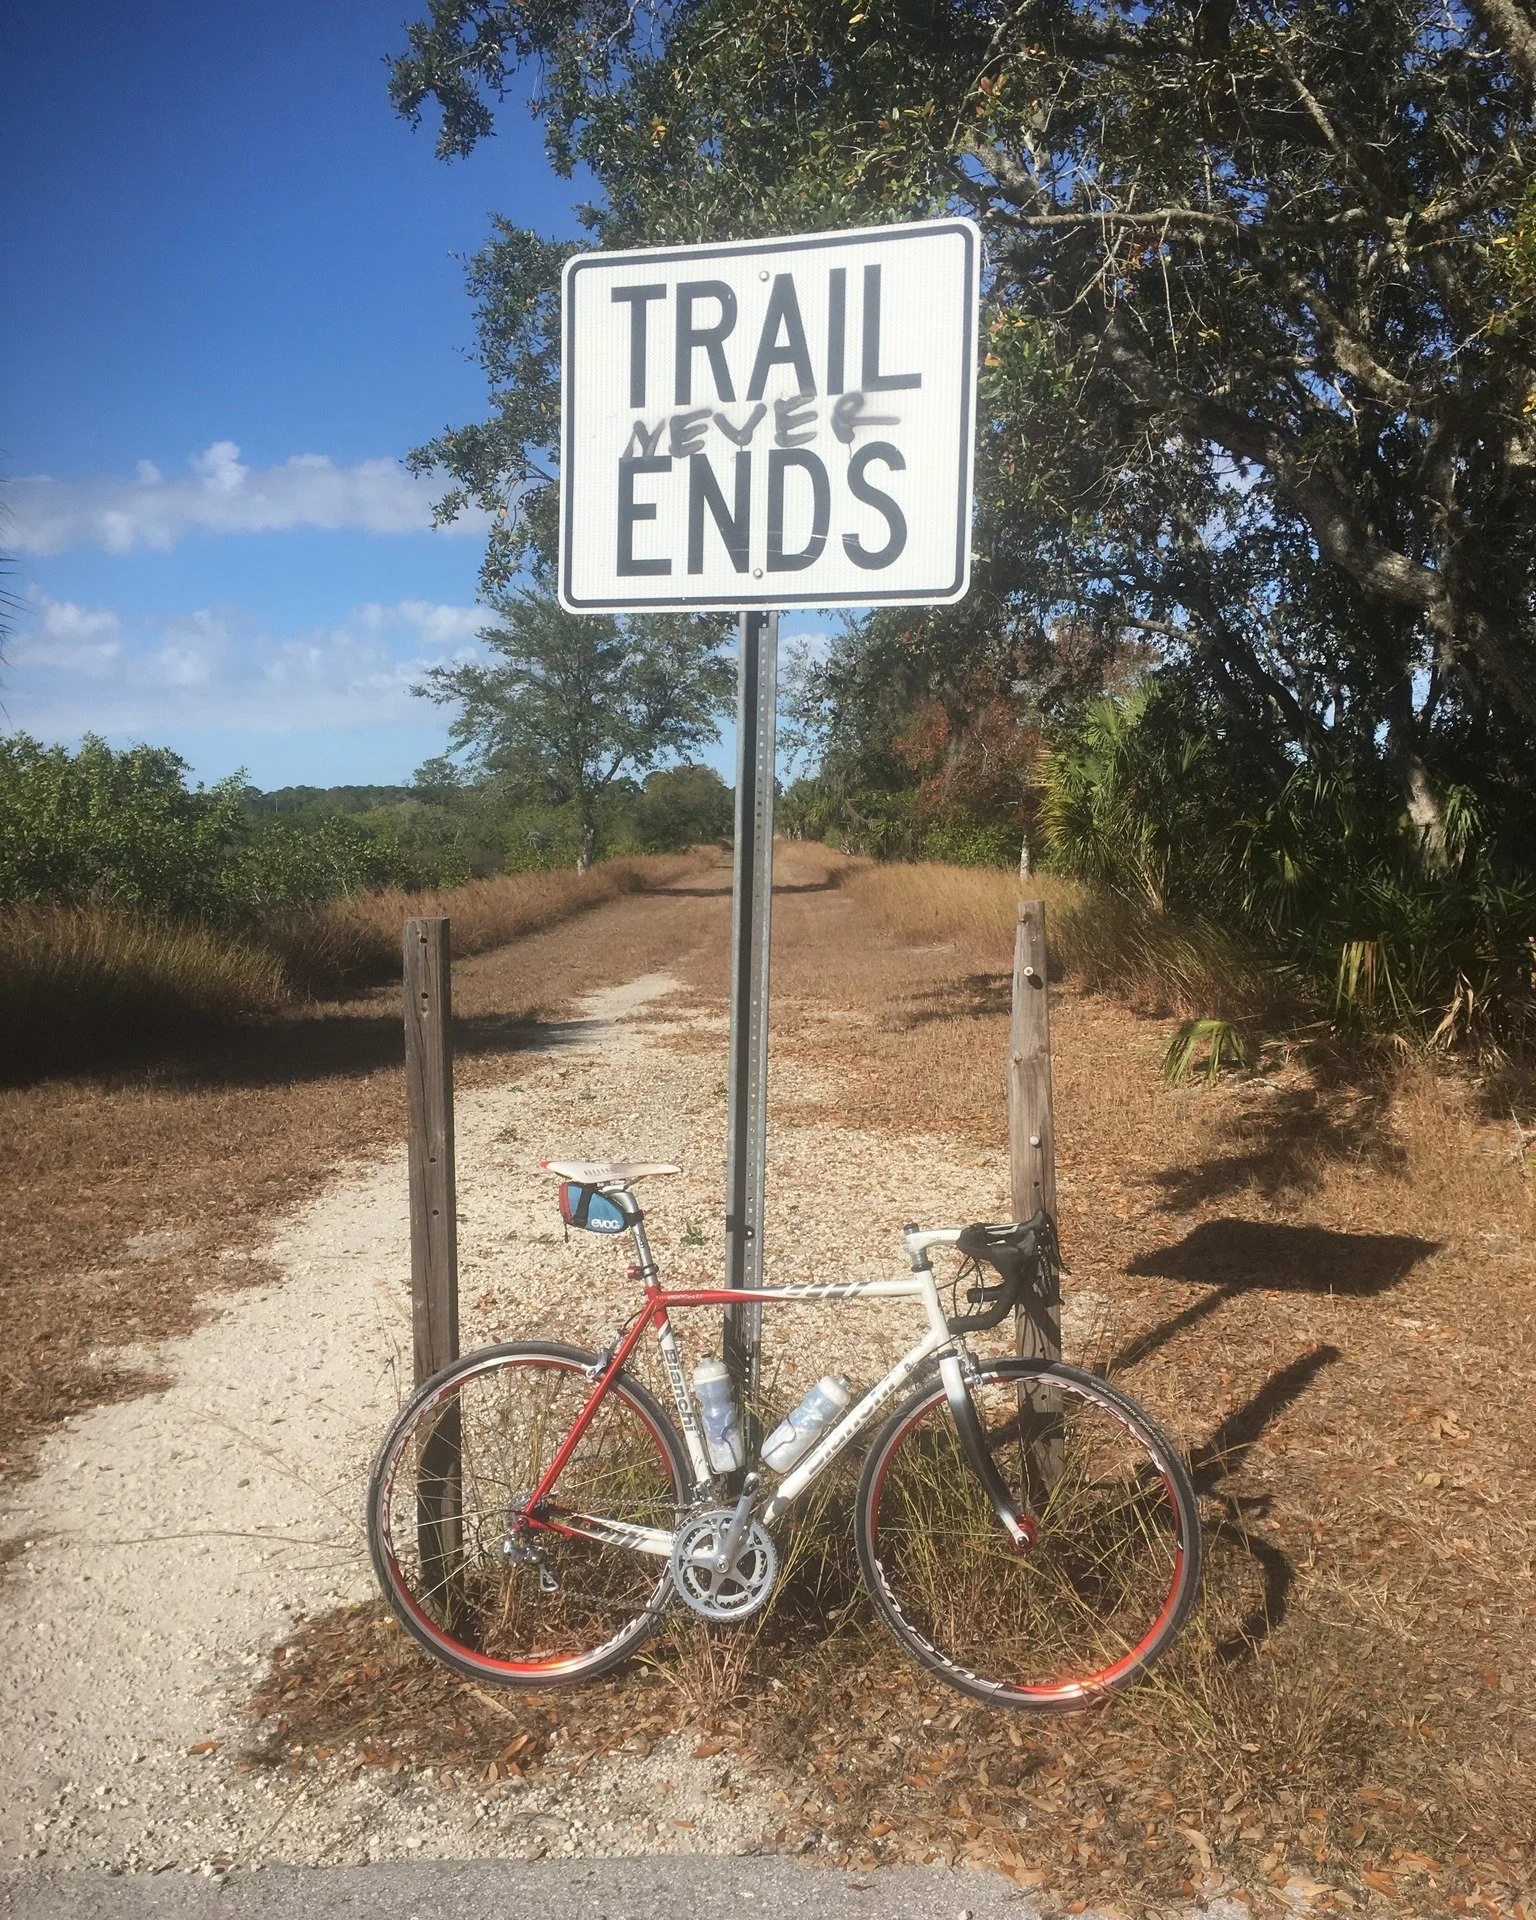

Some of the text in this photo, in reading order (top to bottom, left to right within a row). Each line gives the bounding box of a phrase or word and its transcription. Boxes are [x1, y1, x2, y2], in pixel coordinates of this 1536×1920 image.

[611, 264, 922, 408] TRAIL
[623, 391, 901, 460] NEVER
[616, 441, 908, 577] ENDS
[591, 1218, 619, 1229] evoc
[664, 1349, 697, 1432] Bianchi
